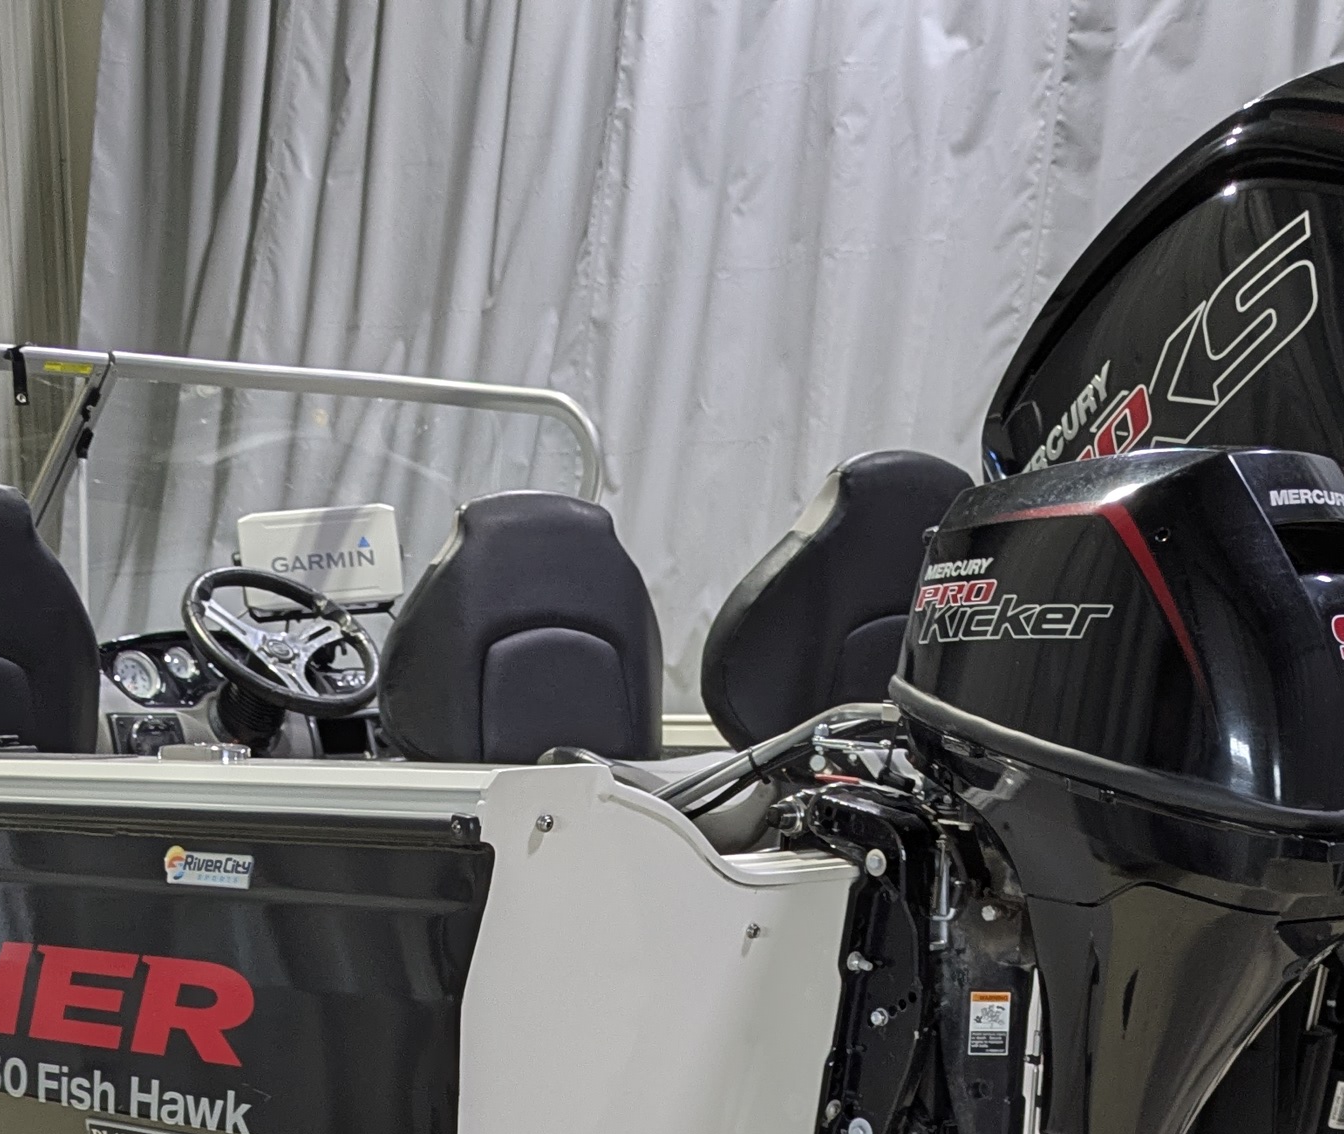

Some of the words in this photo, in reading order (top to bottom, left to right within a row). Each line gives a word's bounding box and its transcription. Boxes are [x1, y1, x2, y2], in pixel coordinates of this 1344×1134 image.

[1021, 360, 1111, 473] RCURY
[271, 549, 375, 573] GARMIN
[925, 557, 994, 580] MERCURY
[915, 579, 998, 611] PRO
[37, 1062, 115, 1115] Fish
